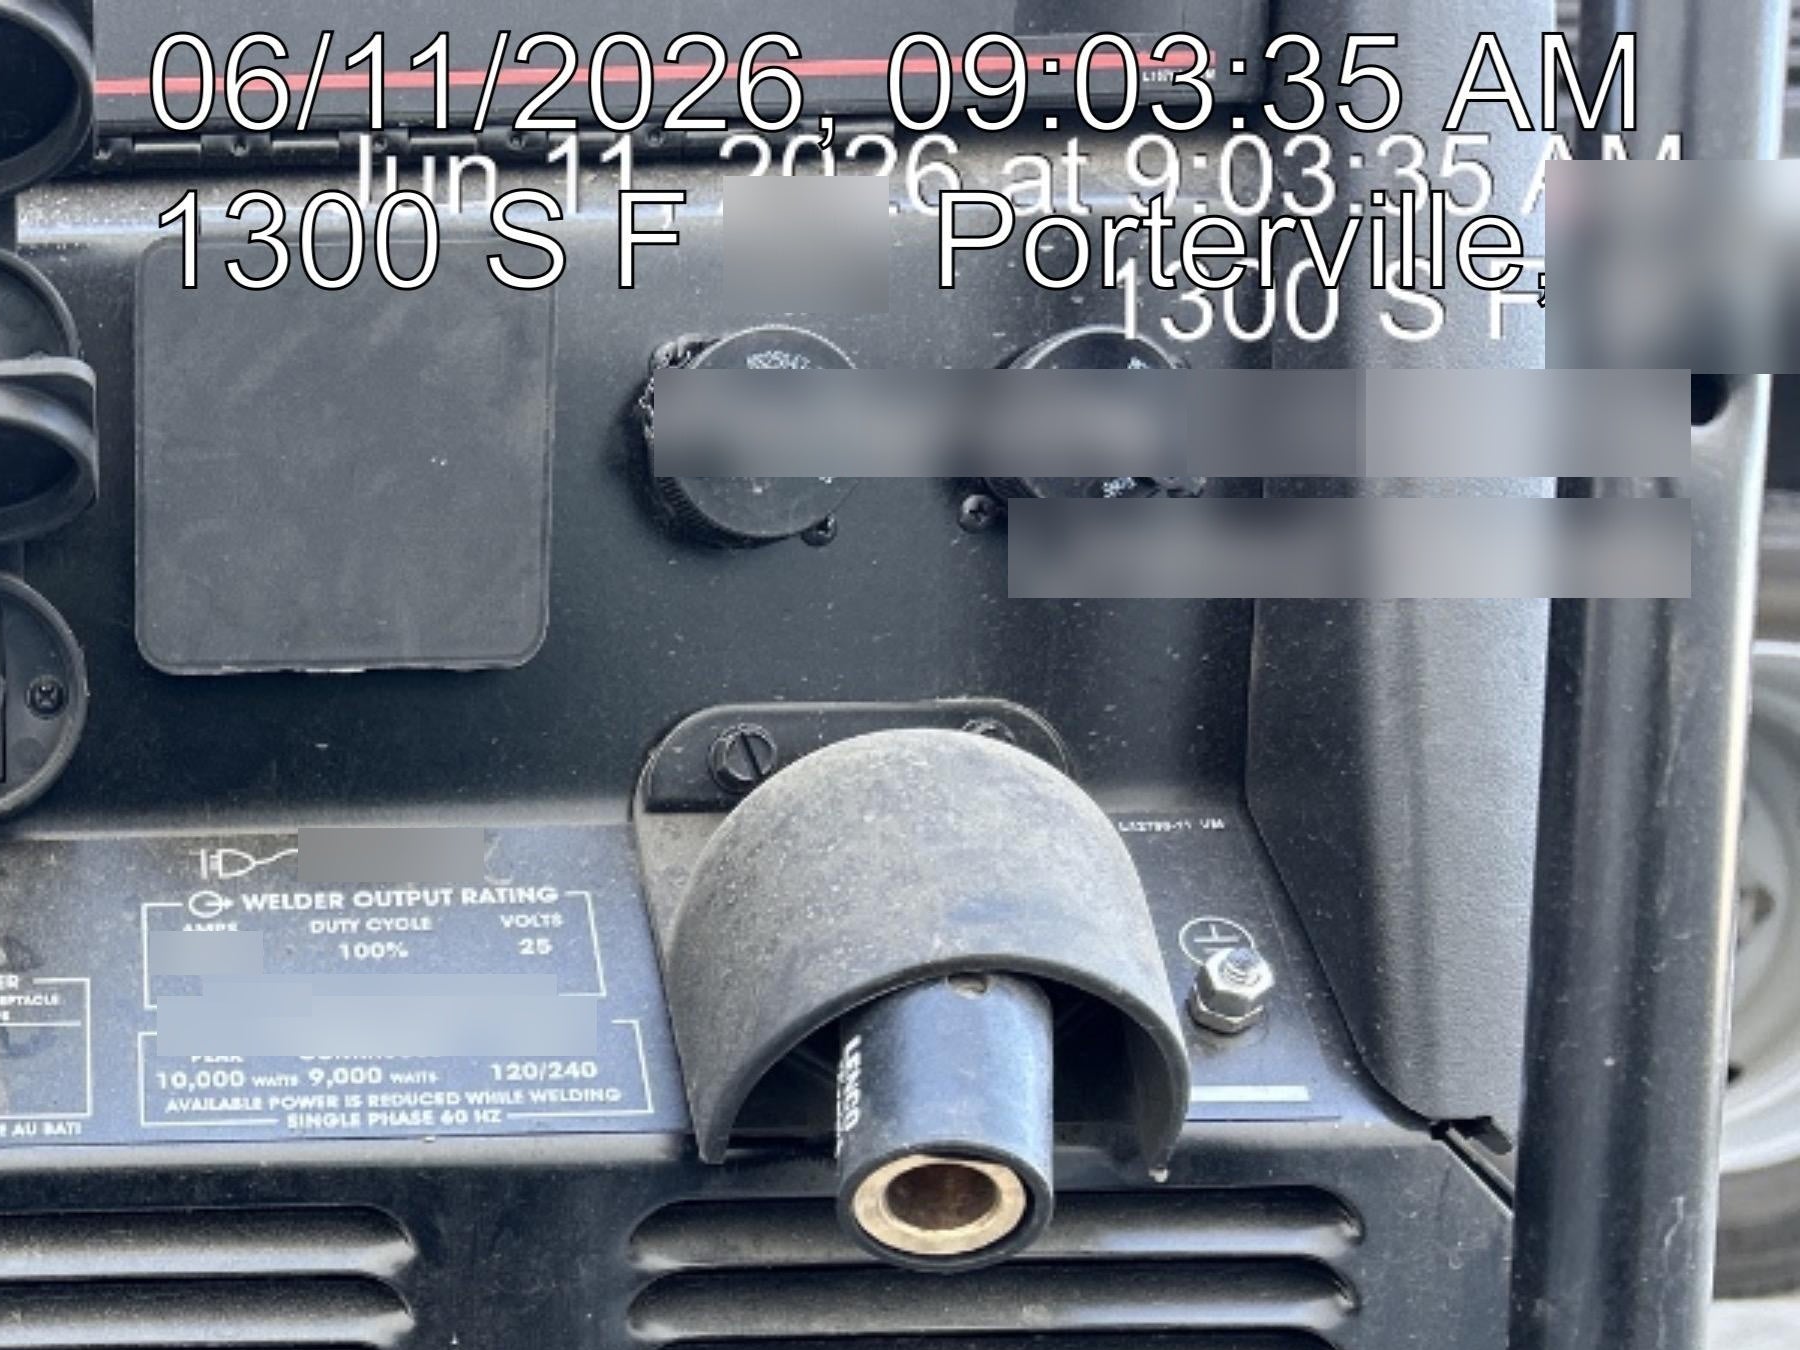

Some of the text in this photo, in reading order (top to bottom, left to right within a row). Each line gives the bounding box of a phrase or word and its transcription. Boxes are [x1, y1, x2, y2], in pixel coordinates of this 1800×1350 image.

[241, 886, 559, 911] WELDER OUTPUT RATING
[310, 916, 433, 934] DUTY CYCLE
[500, 912, 563, 929] VOLTS
[338, 941, 409, 960] 100%
[519, 937, 553, 956] 25
[156, 1067, 439, 1092] 10,000 WATTS 9,000 WATTS
[490, 1060, 598, 1081] 120/240
[841, 1034, 863, 1132] LENCO
[165, 1086, 622, 1113] AVAILABLE POWER IS REDUCED WHILE WELDING
[11, 1120, 38, 1136] AU
[43, 1120, 83, 1136] BATI
[286, 1107, 503, 1129] SINGLE PHASE 60 HZ
